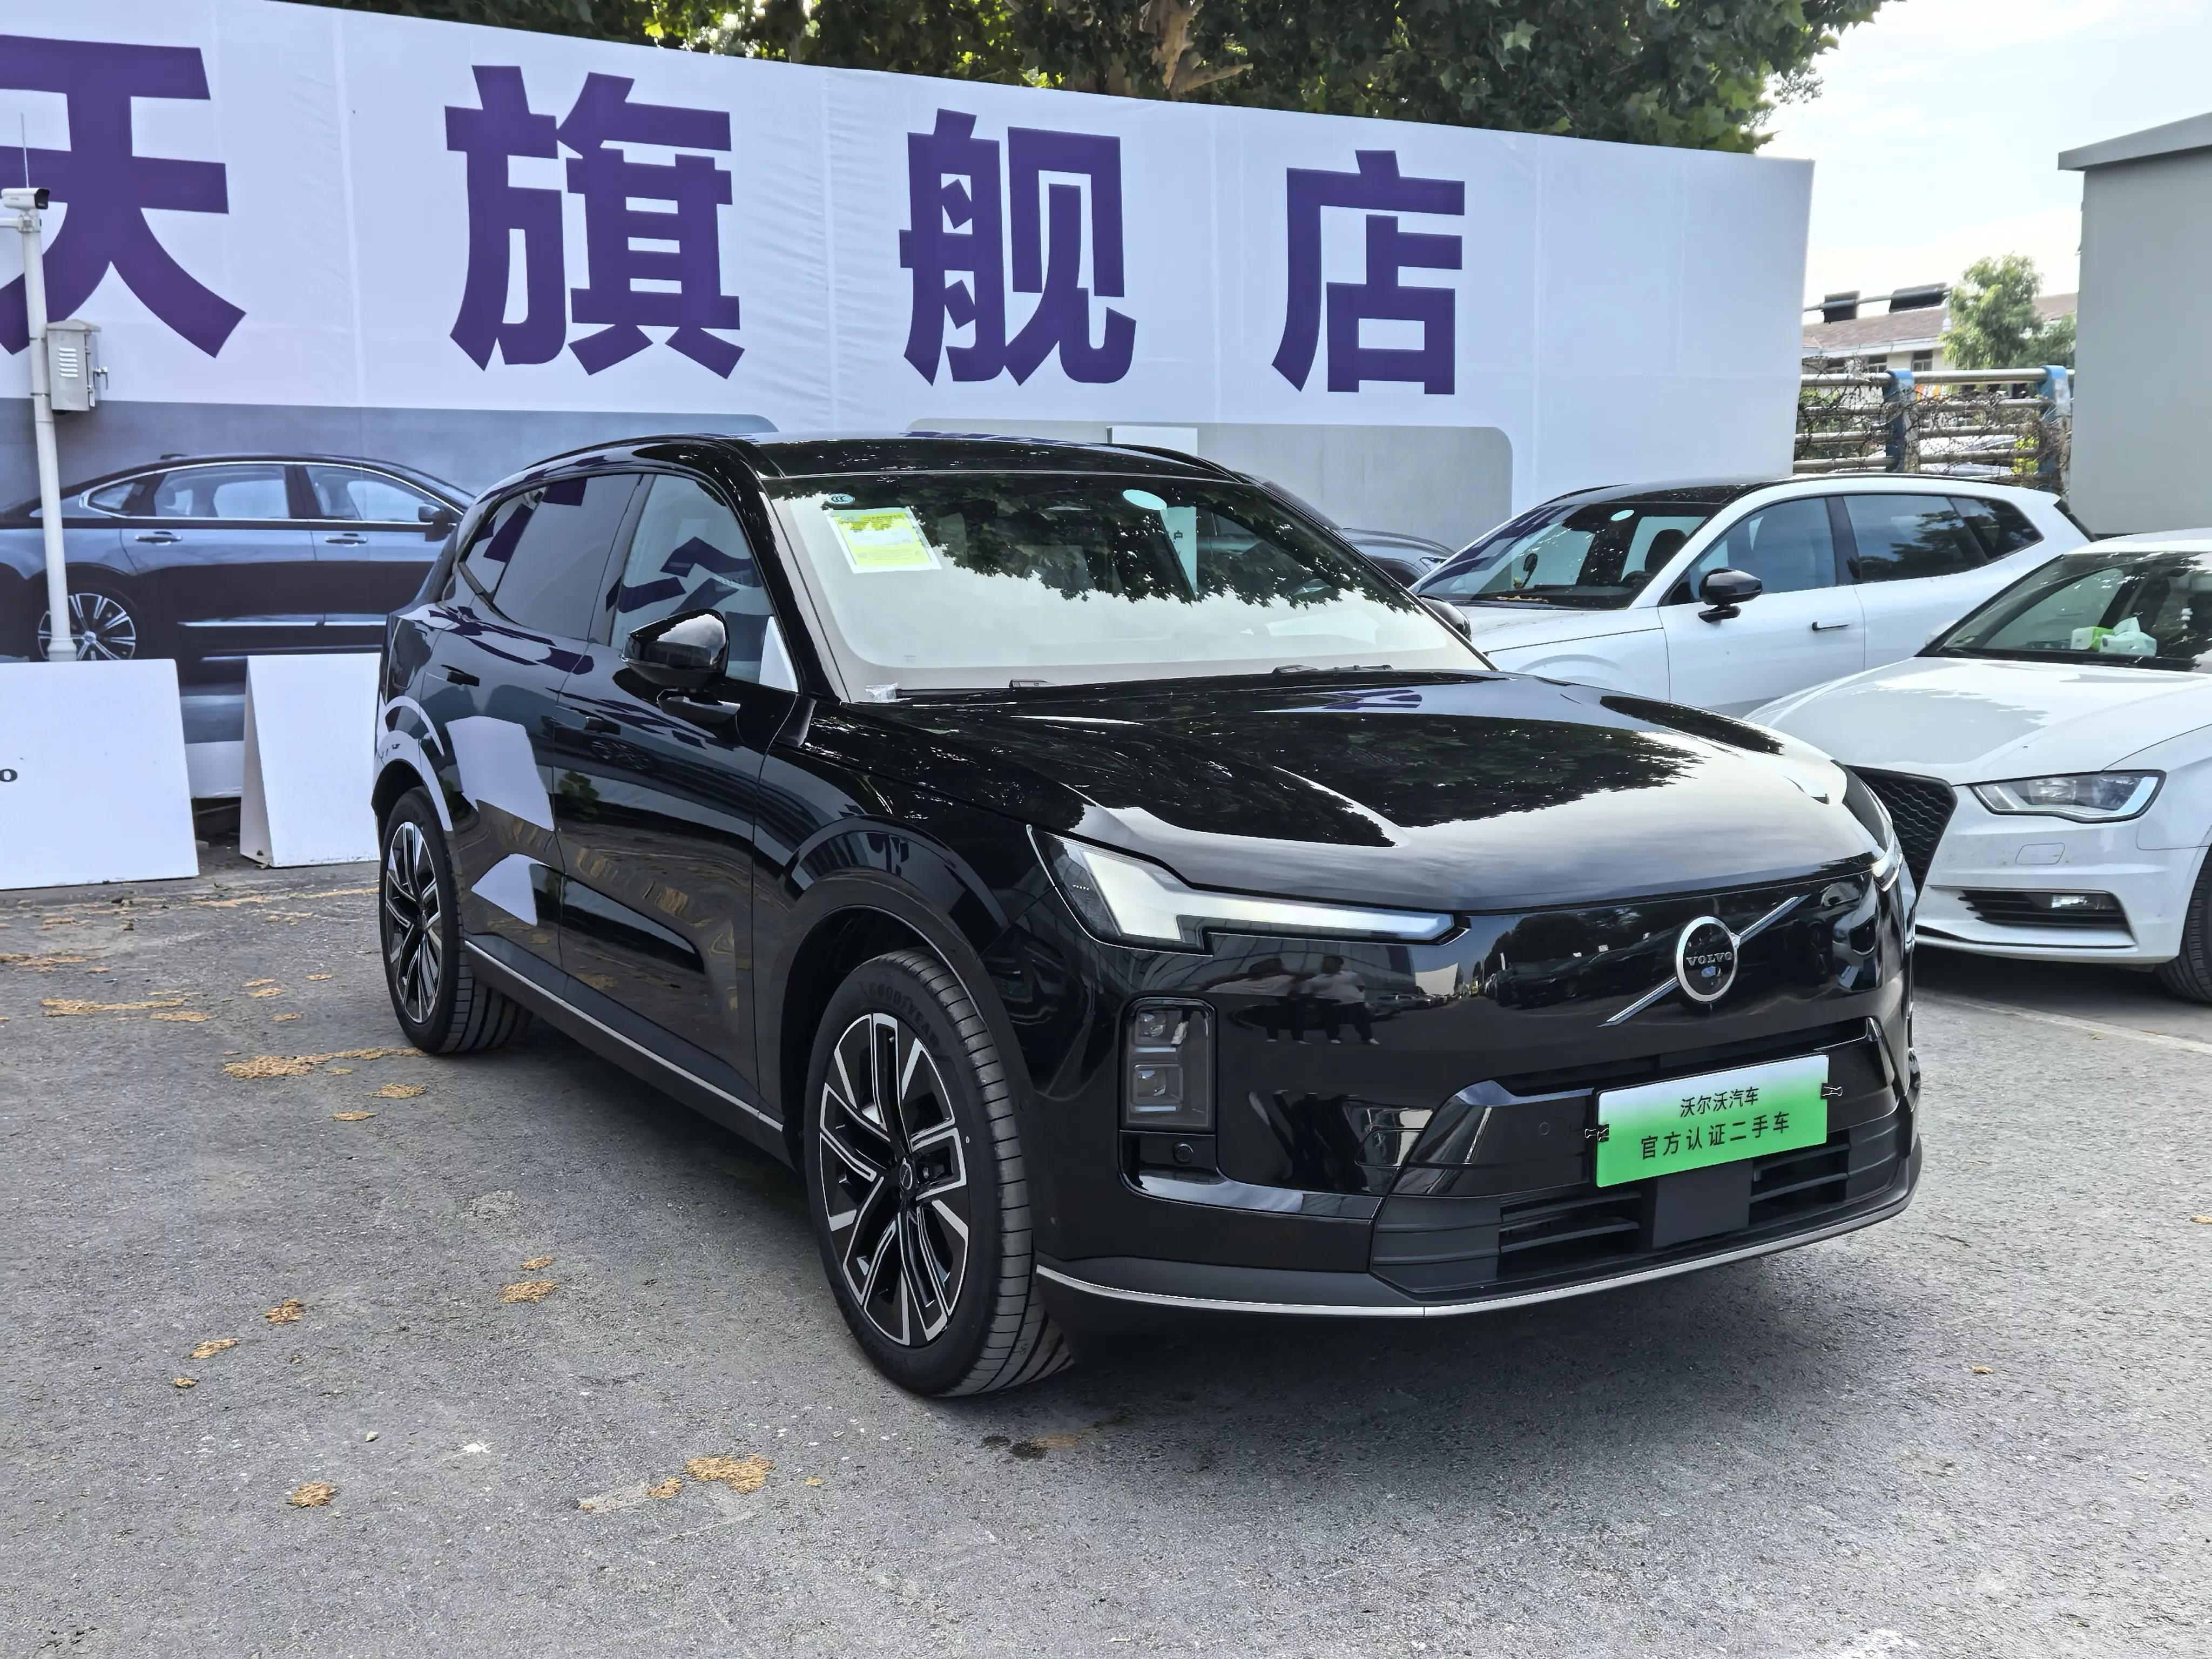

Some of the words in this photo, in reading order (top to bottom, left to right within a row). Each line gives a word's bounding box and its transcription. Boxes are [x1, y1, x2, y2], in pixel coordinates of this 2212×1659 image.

[1685, 951, 1733, 966] VOLVO
[868, 982, 940, 1049] GOODYEAR
[1680, 1086, 1759, 1118] 沃尔沃汽车
[1641, 1111, 1789, 1160] 官方认证二手车
